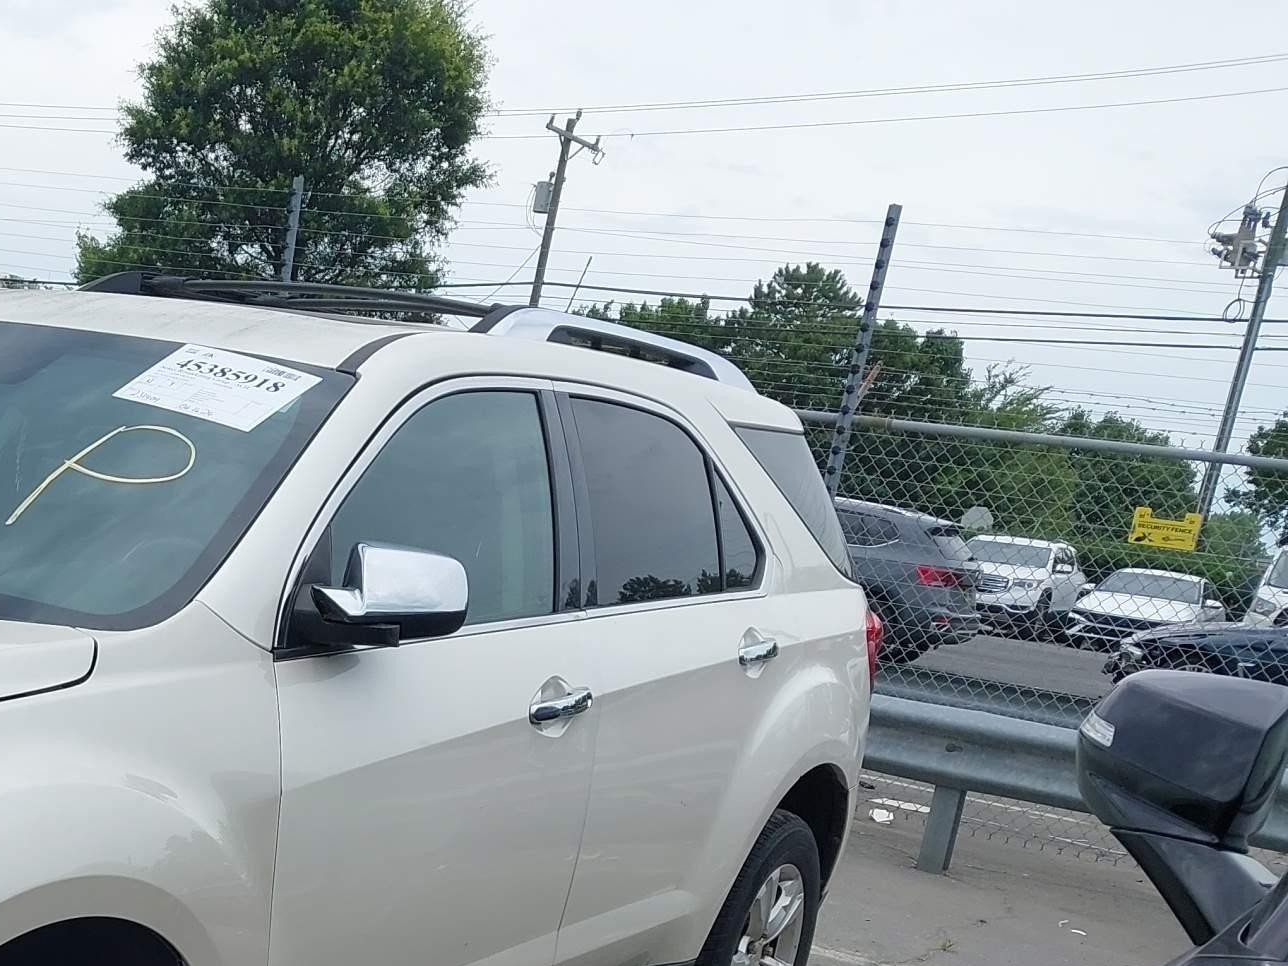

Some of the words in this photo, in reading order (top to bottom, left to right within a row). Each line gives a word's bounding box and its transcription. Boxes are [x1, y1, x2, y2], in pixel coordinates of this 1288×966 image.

[176, 359, 287, 393] 45385918
[5, 424, 196, 525] P
[1137, 523, 1171, 532] SECURITY
[1171, 527, 1193, 535] FENCE
